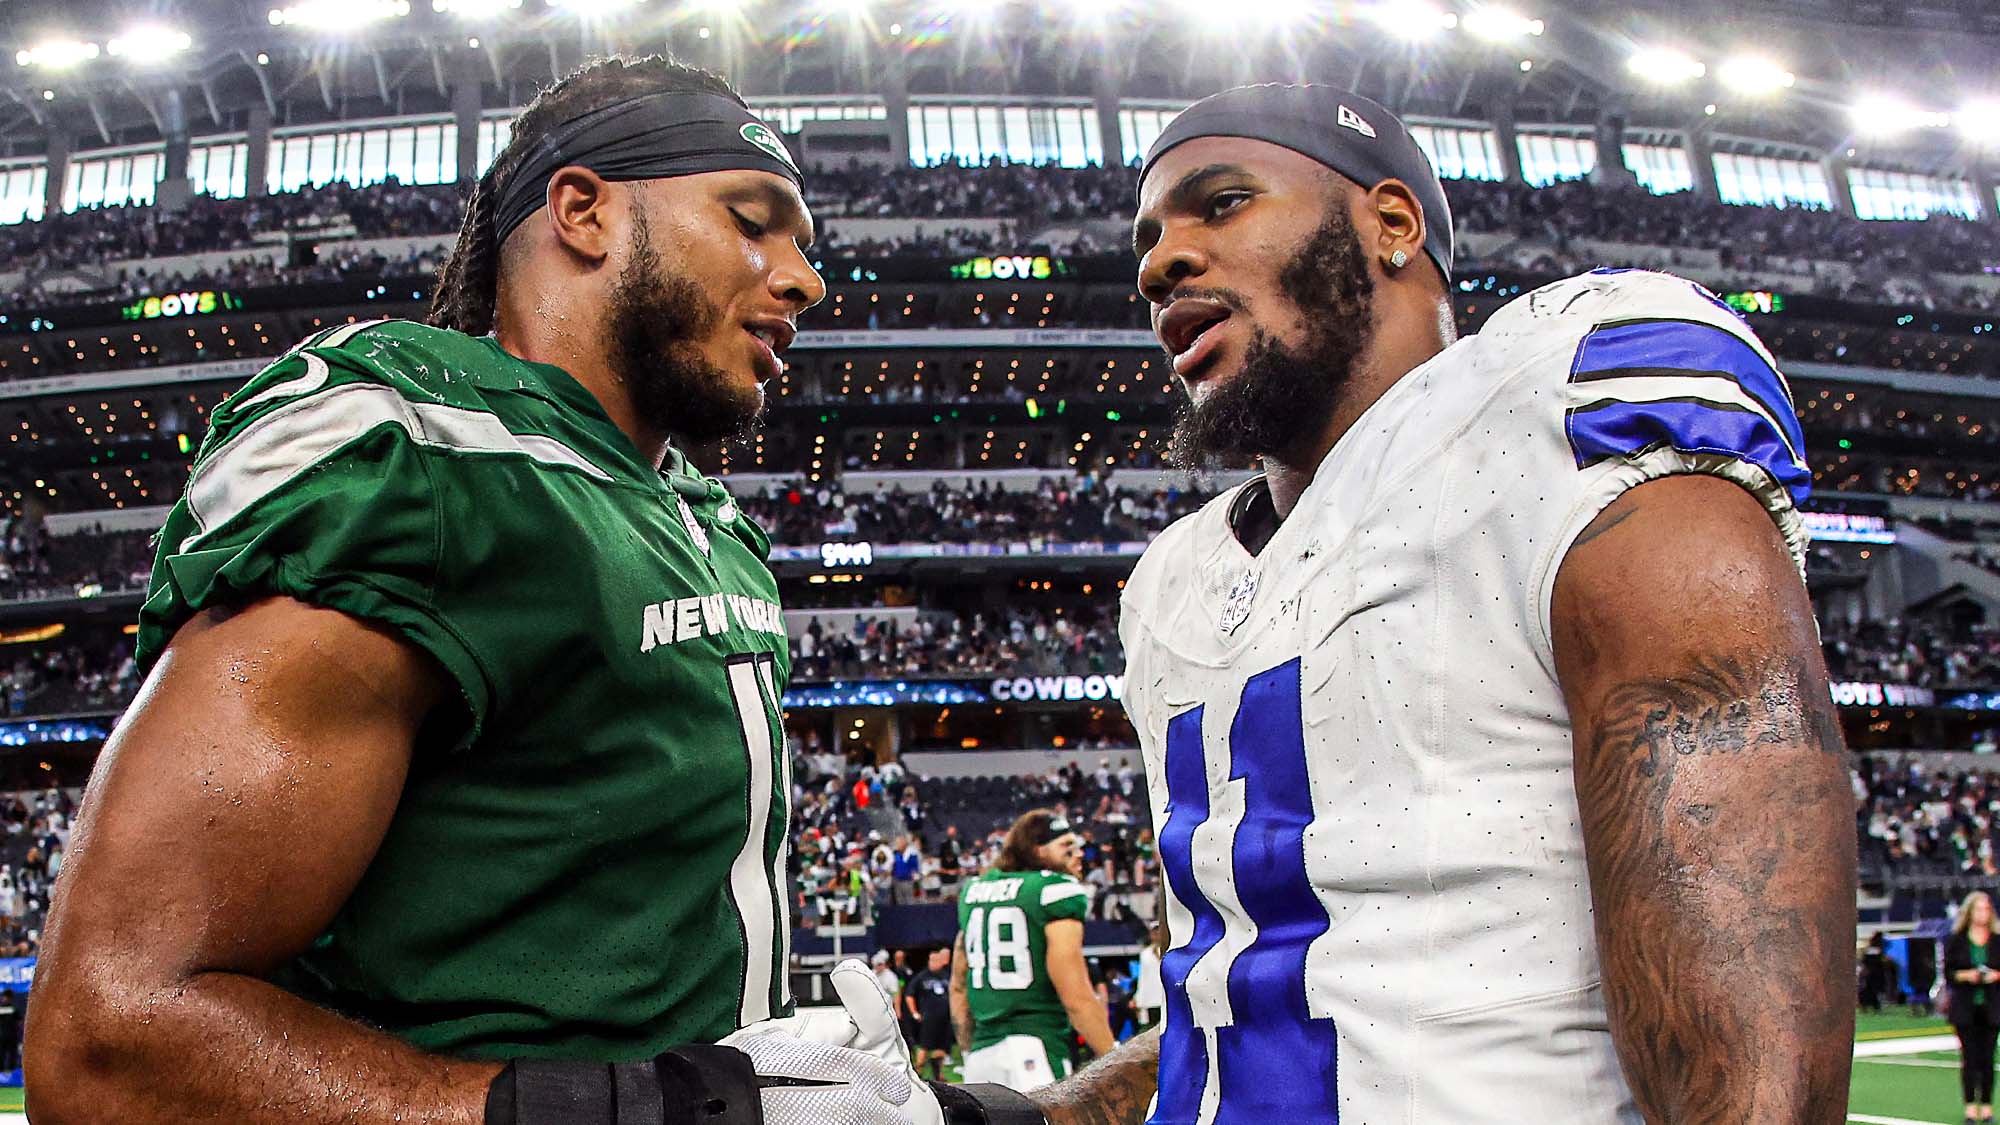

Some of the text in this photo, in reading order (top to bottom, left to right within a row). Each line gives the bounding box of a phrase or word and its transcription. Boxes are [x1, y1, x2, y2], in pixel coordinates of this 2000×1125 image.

[640, 592, 785, 653] NEW YORK
[991, 674, 1125, 701] COWBOY
[1144, 656, 1338, 1125] 11
[965, 906, 1034, 990] 48
